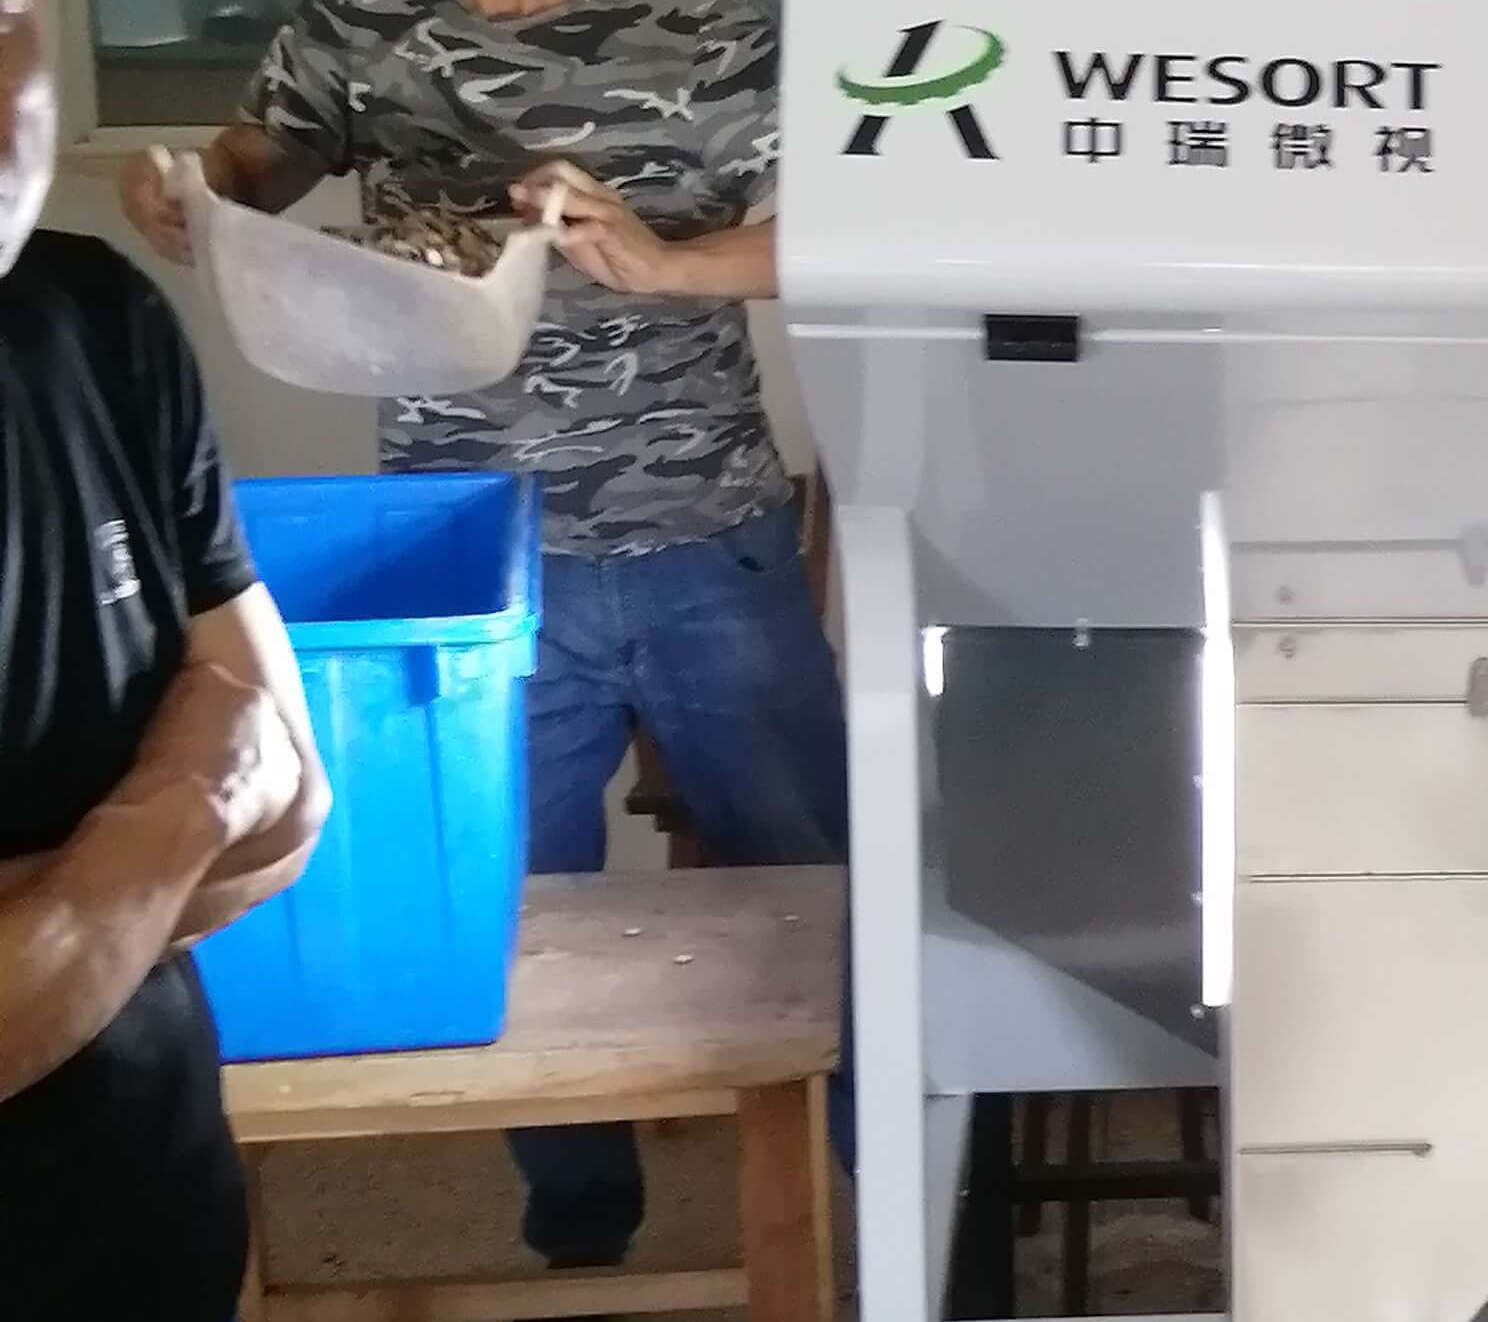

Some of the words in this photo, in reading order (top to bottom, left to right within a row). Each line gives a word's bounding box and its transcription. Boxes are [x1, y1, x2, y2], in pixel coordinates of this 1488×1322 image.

[1053, 50, 1441, 110] WESORT
[1062, 116, 1436, 173] 中瑞微视
